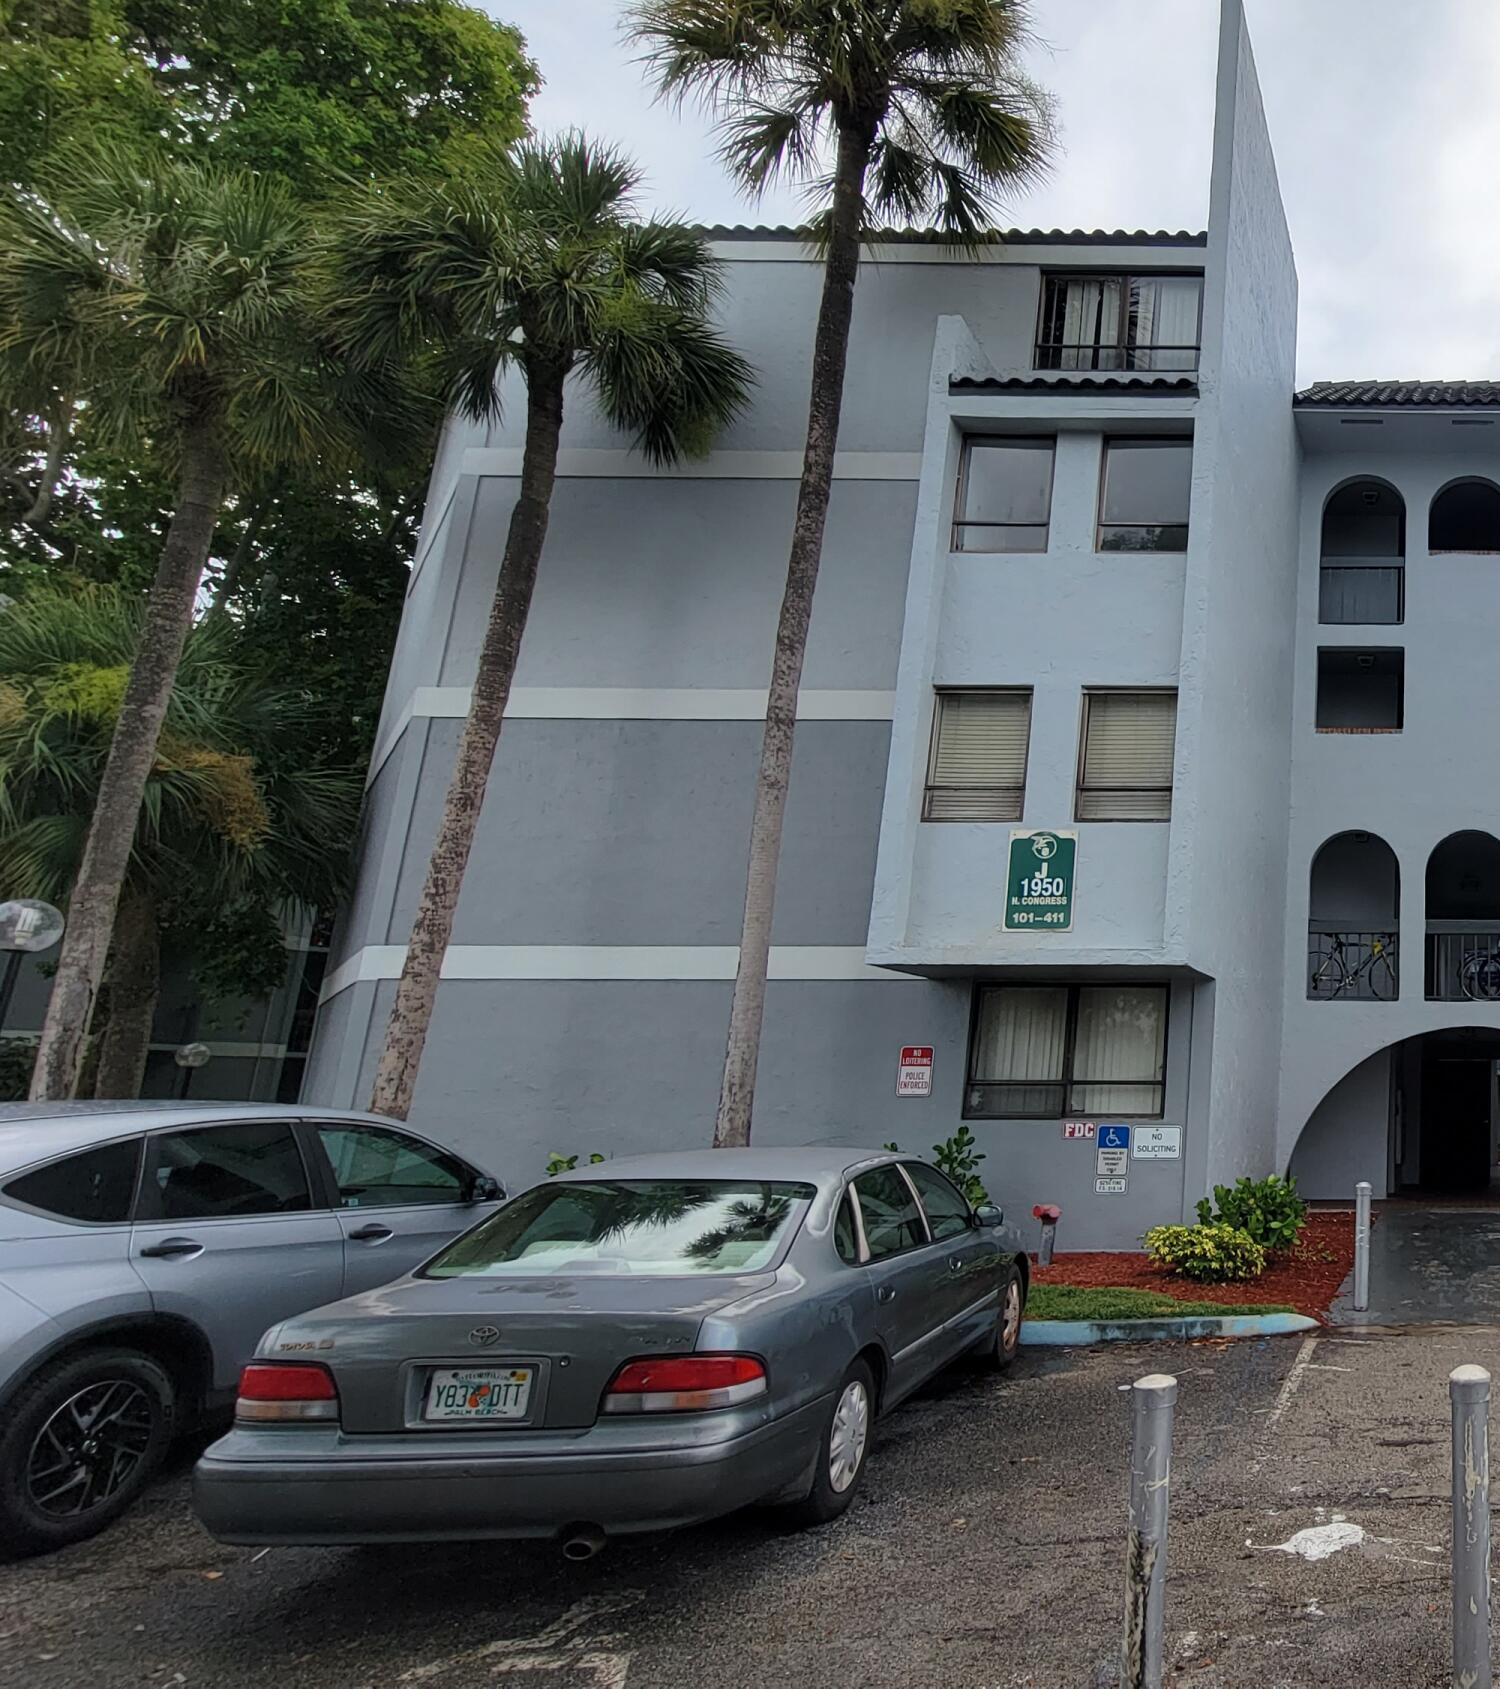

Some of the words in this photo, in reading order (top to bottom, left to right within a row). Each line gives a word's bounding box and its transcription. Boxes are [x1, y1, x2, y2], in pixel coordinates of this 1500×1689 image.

[1034, 862, 1048, 878] J
[1021, 878, 1064, 896] 1950
[1011, 896, 1020, 905] N.
[1022, 896, 1067, 905] CONGRESS
[1013, 912, 1065, 923] 101-411
[913, 1049, 922, 1057] NO
[902, 1057, 932, 1065] LOITERING
[905, 1071, 926, 1080] POLICE
[900, 1080, 929, 1089] ENFORCED
[1064, 1123, 1095, 1138] FDC
[1151, 1133, 1163, 1141] NO
[1137, 1145, 1177, 1153] SOLICITING
[435, 1384, 469, 1408] Y83
